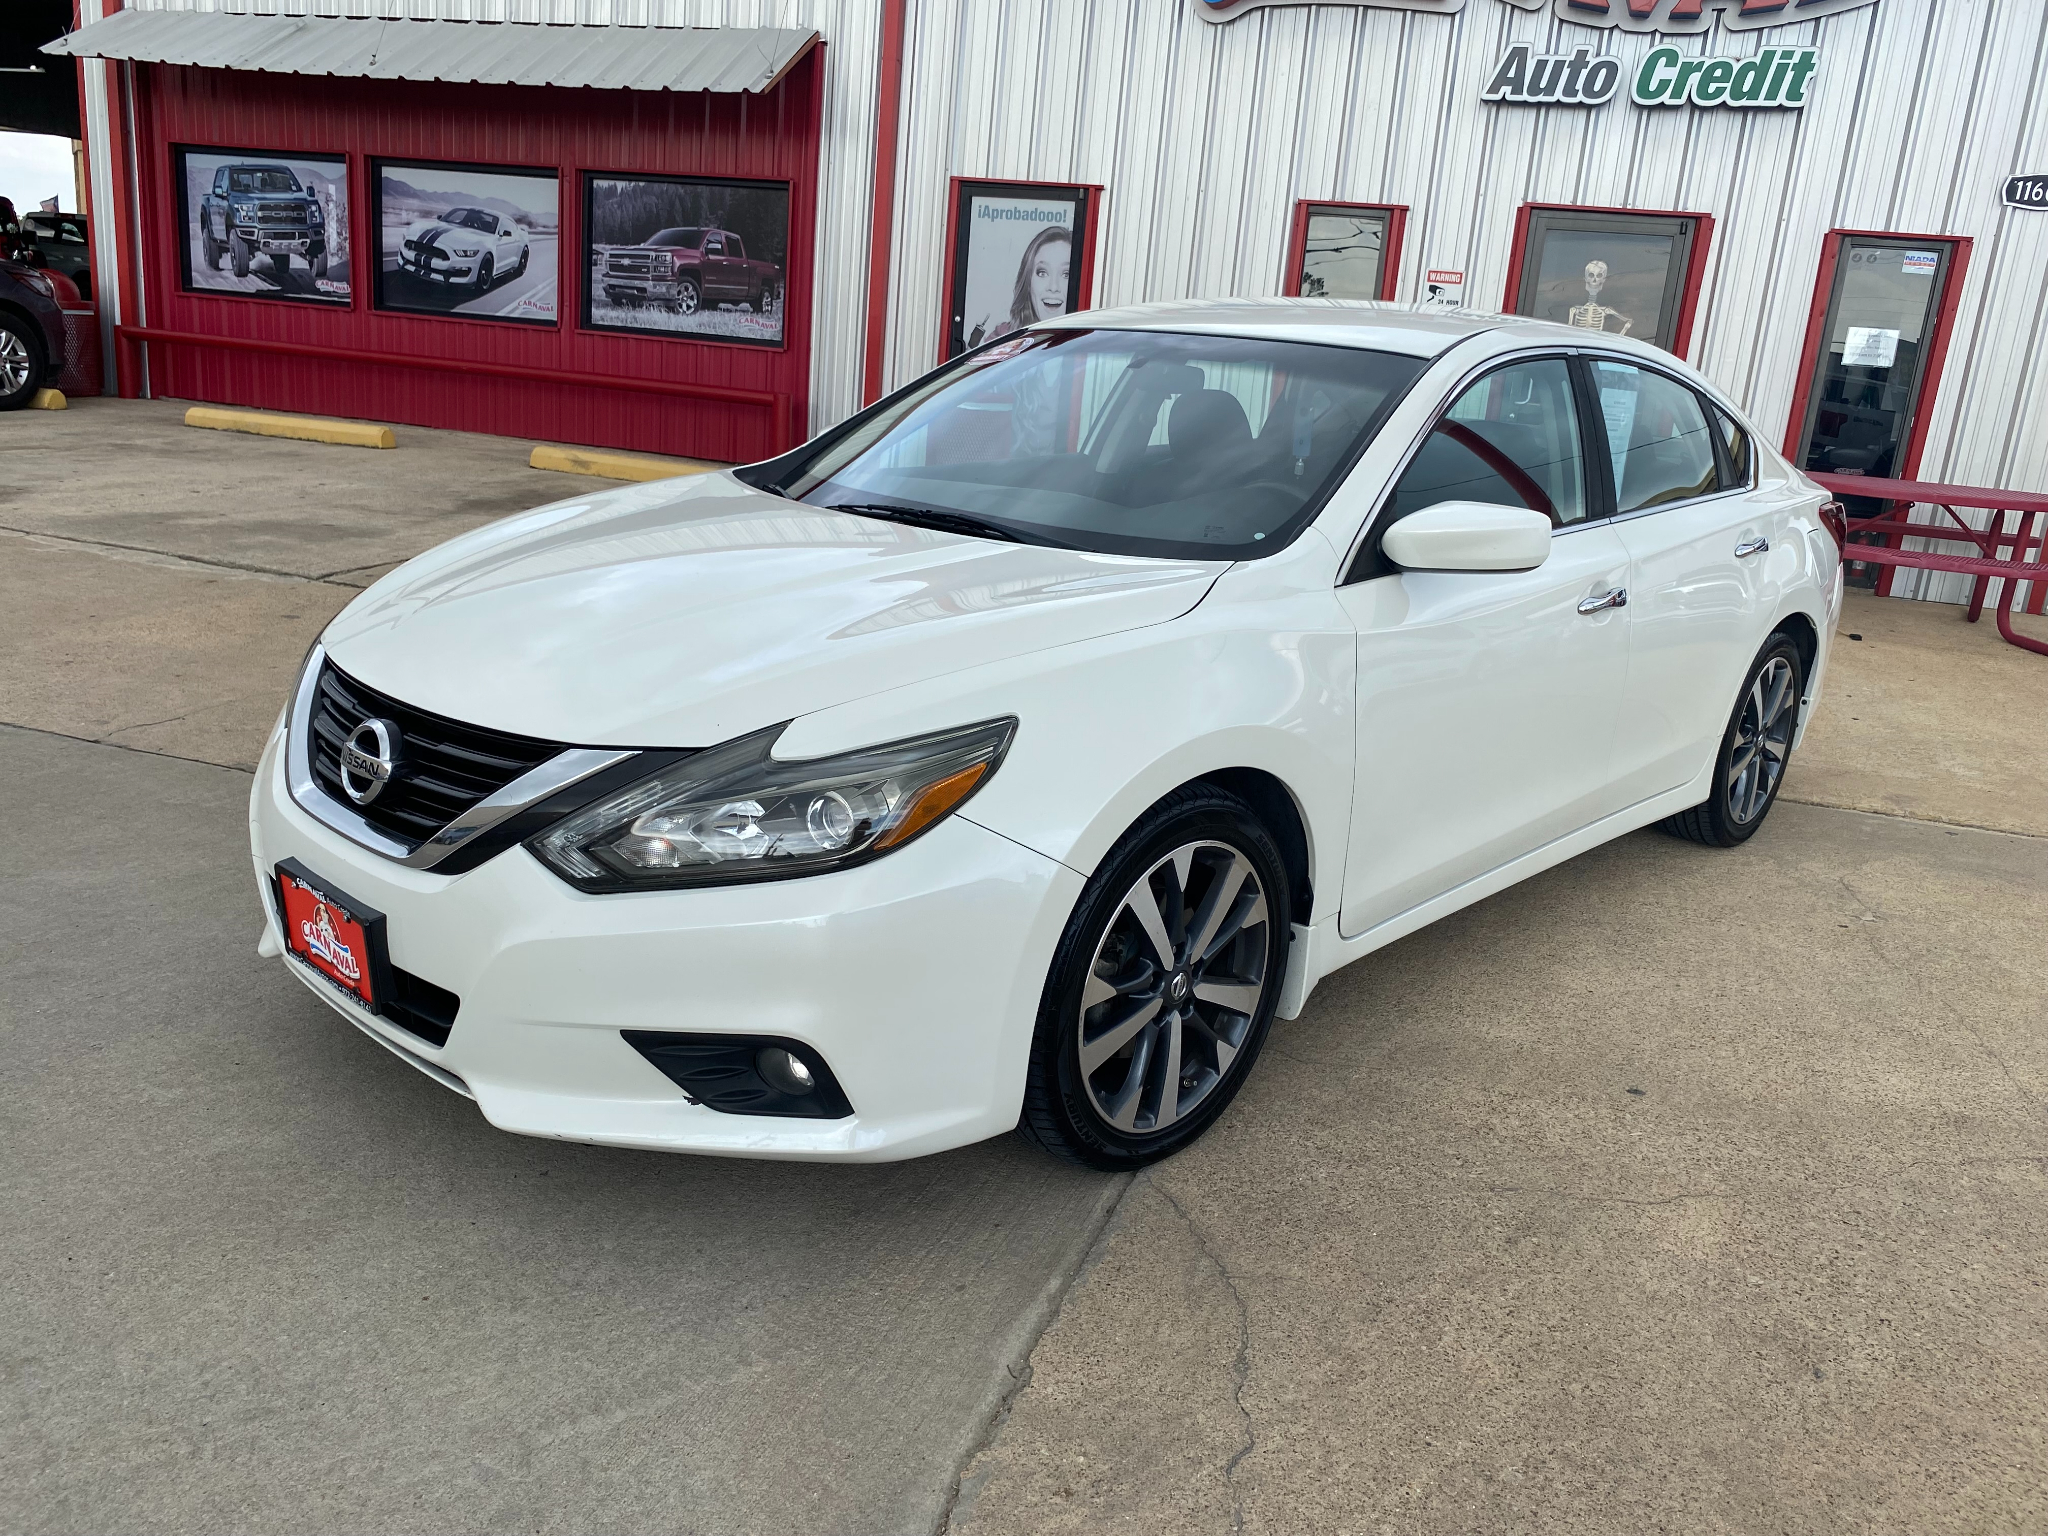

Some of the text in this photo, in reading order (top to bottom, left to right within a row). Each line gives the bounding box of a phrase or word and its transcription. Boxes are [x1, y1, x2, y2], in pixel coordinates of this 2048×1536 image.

[1485, 45, 1816, 103] Auto Credit
[2015, 180, 2048, 202] 116
[261, 210, 305, 218] FORD
[1905, 255, 1936, 263] NIADA
[1429, 271, 1461, 283] WARNING
[315, 280, 350, 293] CARNAVAL
[517, 299, 554, 313] CARNAVAL
[738, 316, 779, 331] CARNAVAL
[342, 748, 380, 776] NISSAN
[302, 920, 360, 976] CARNAVAL
